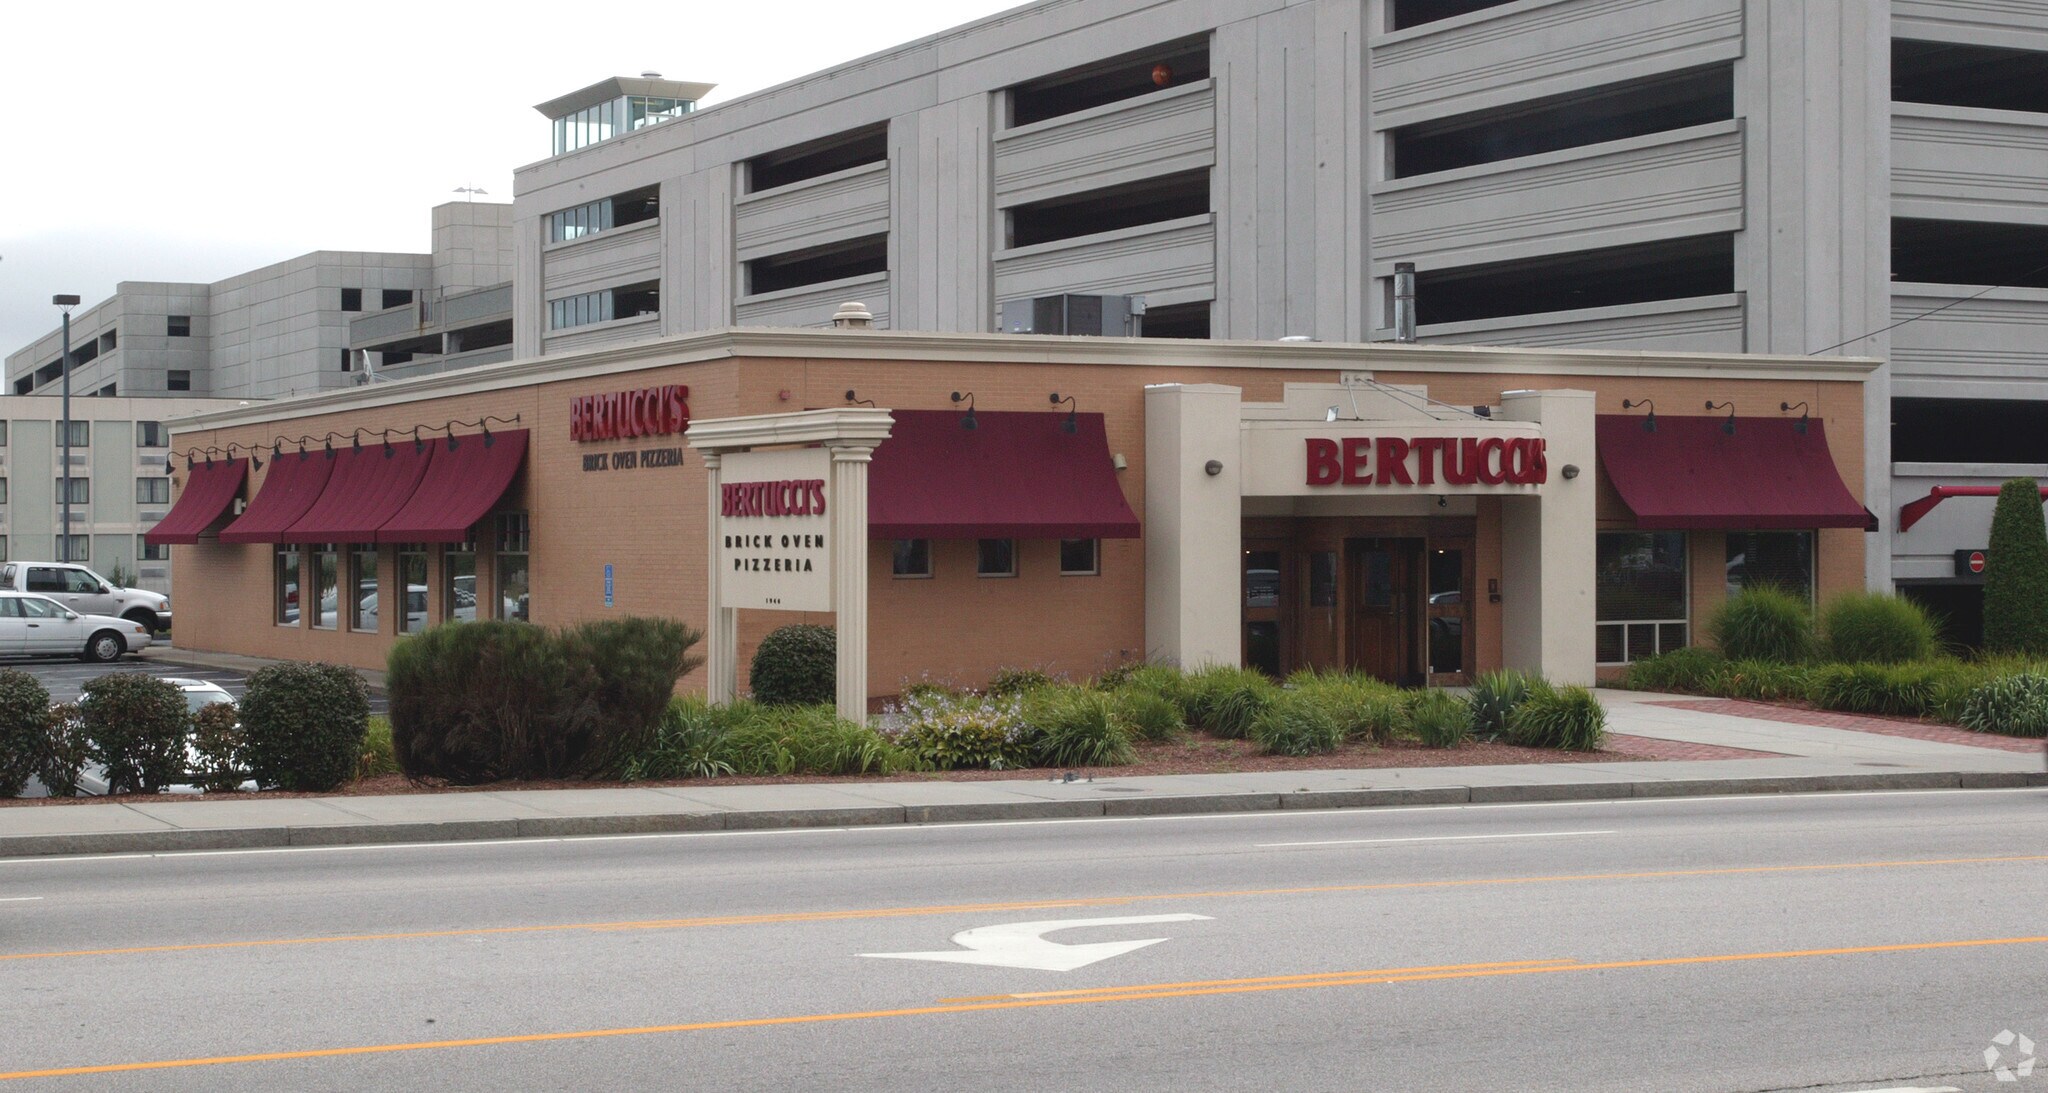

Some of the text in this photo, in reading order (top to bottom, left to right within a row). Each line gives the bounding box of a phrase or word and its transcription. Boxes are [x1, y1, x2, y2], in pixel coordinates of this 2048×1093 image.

[569, 384, 690, 442] BERTUCCI'S
[582, 447, 684, 472] BRICK OVEN PIZZERIA
[720, 479, 826, 518] BERTUCCI'S
[724, 534, 824, 548] BRICK OVEN
[734, 558, 813, 572] PIZZERIA
